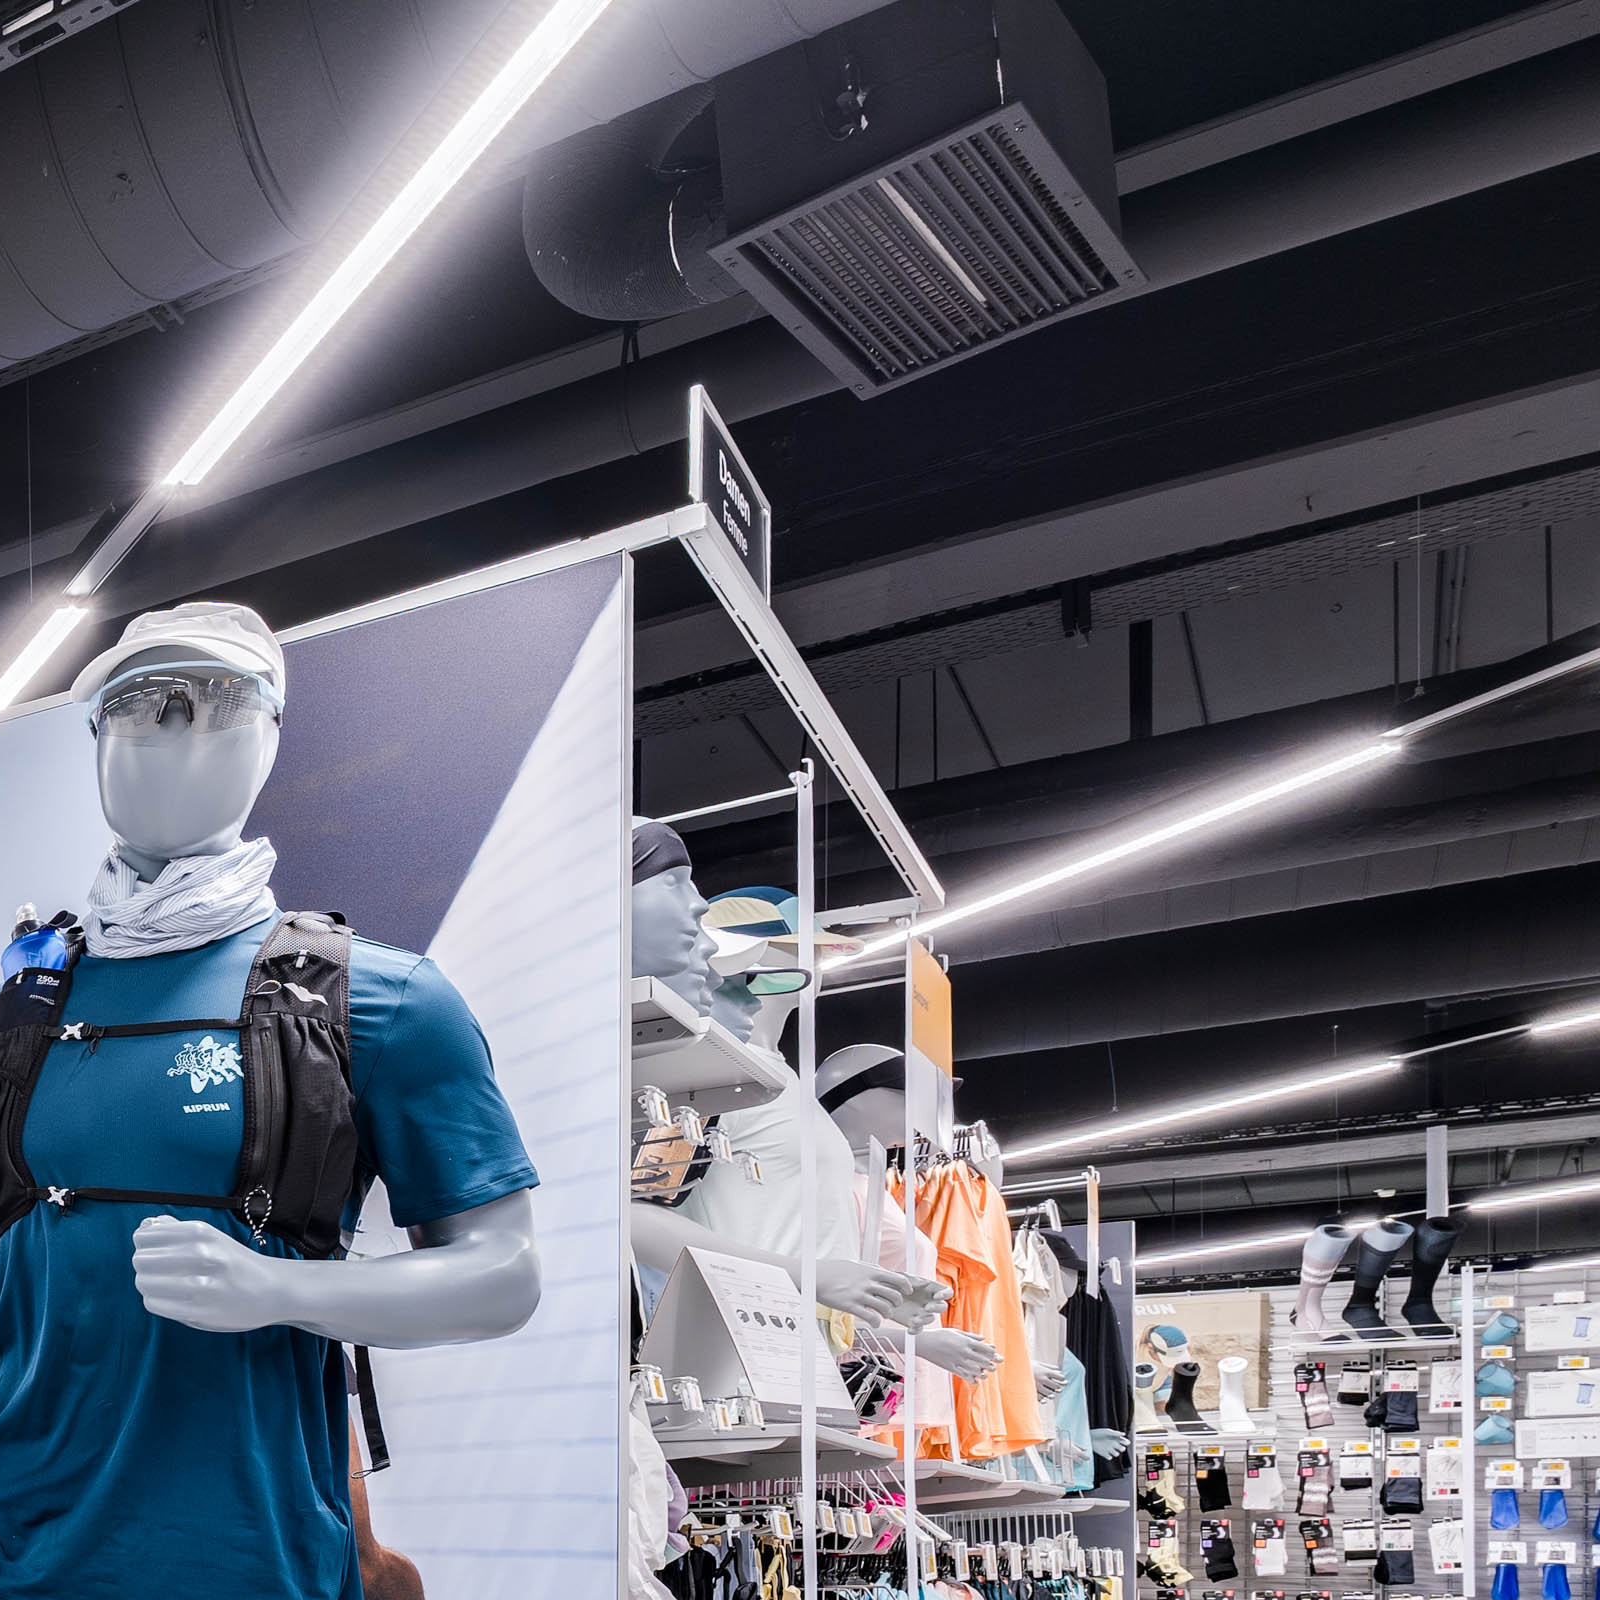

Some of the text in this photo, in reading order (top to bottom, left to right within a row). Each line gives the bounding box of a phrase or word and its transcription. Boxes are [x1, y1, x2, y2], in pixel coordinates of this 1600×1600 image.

[719, 448, 751, 528] Damen
[723, 499, 748, 557] Femme
[183, 1102, 231, 1114] KIPRUN
